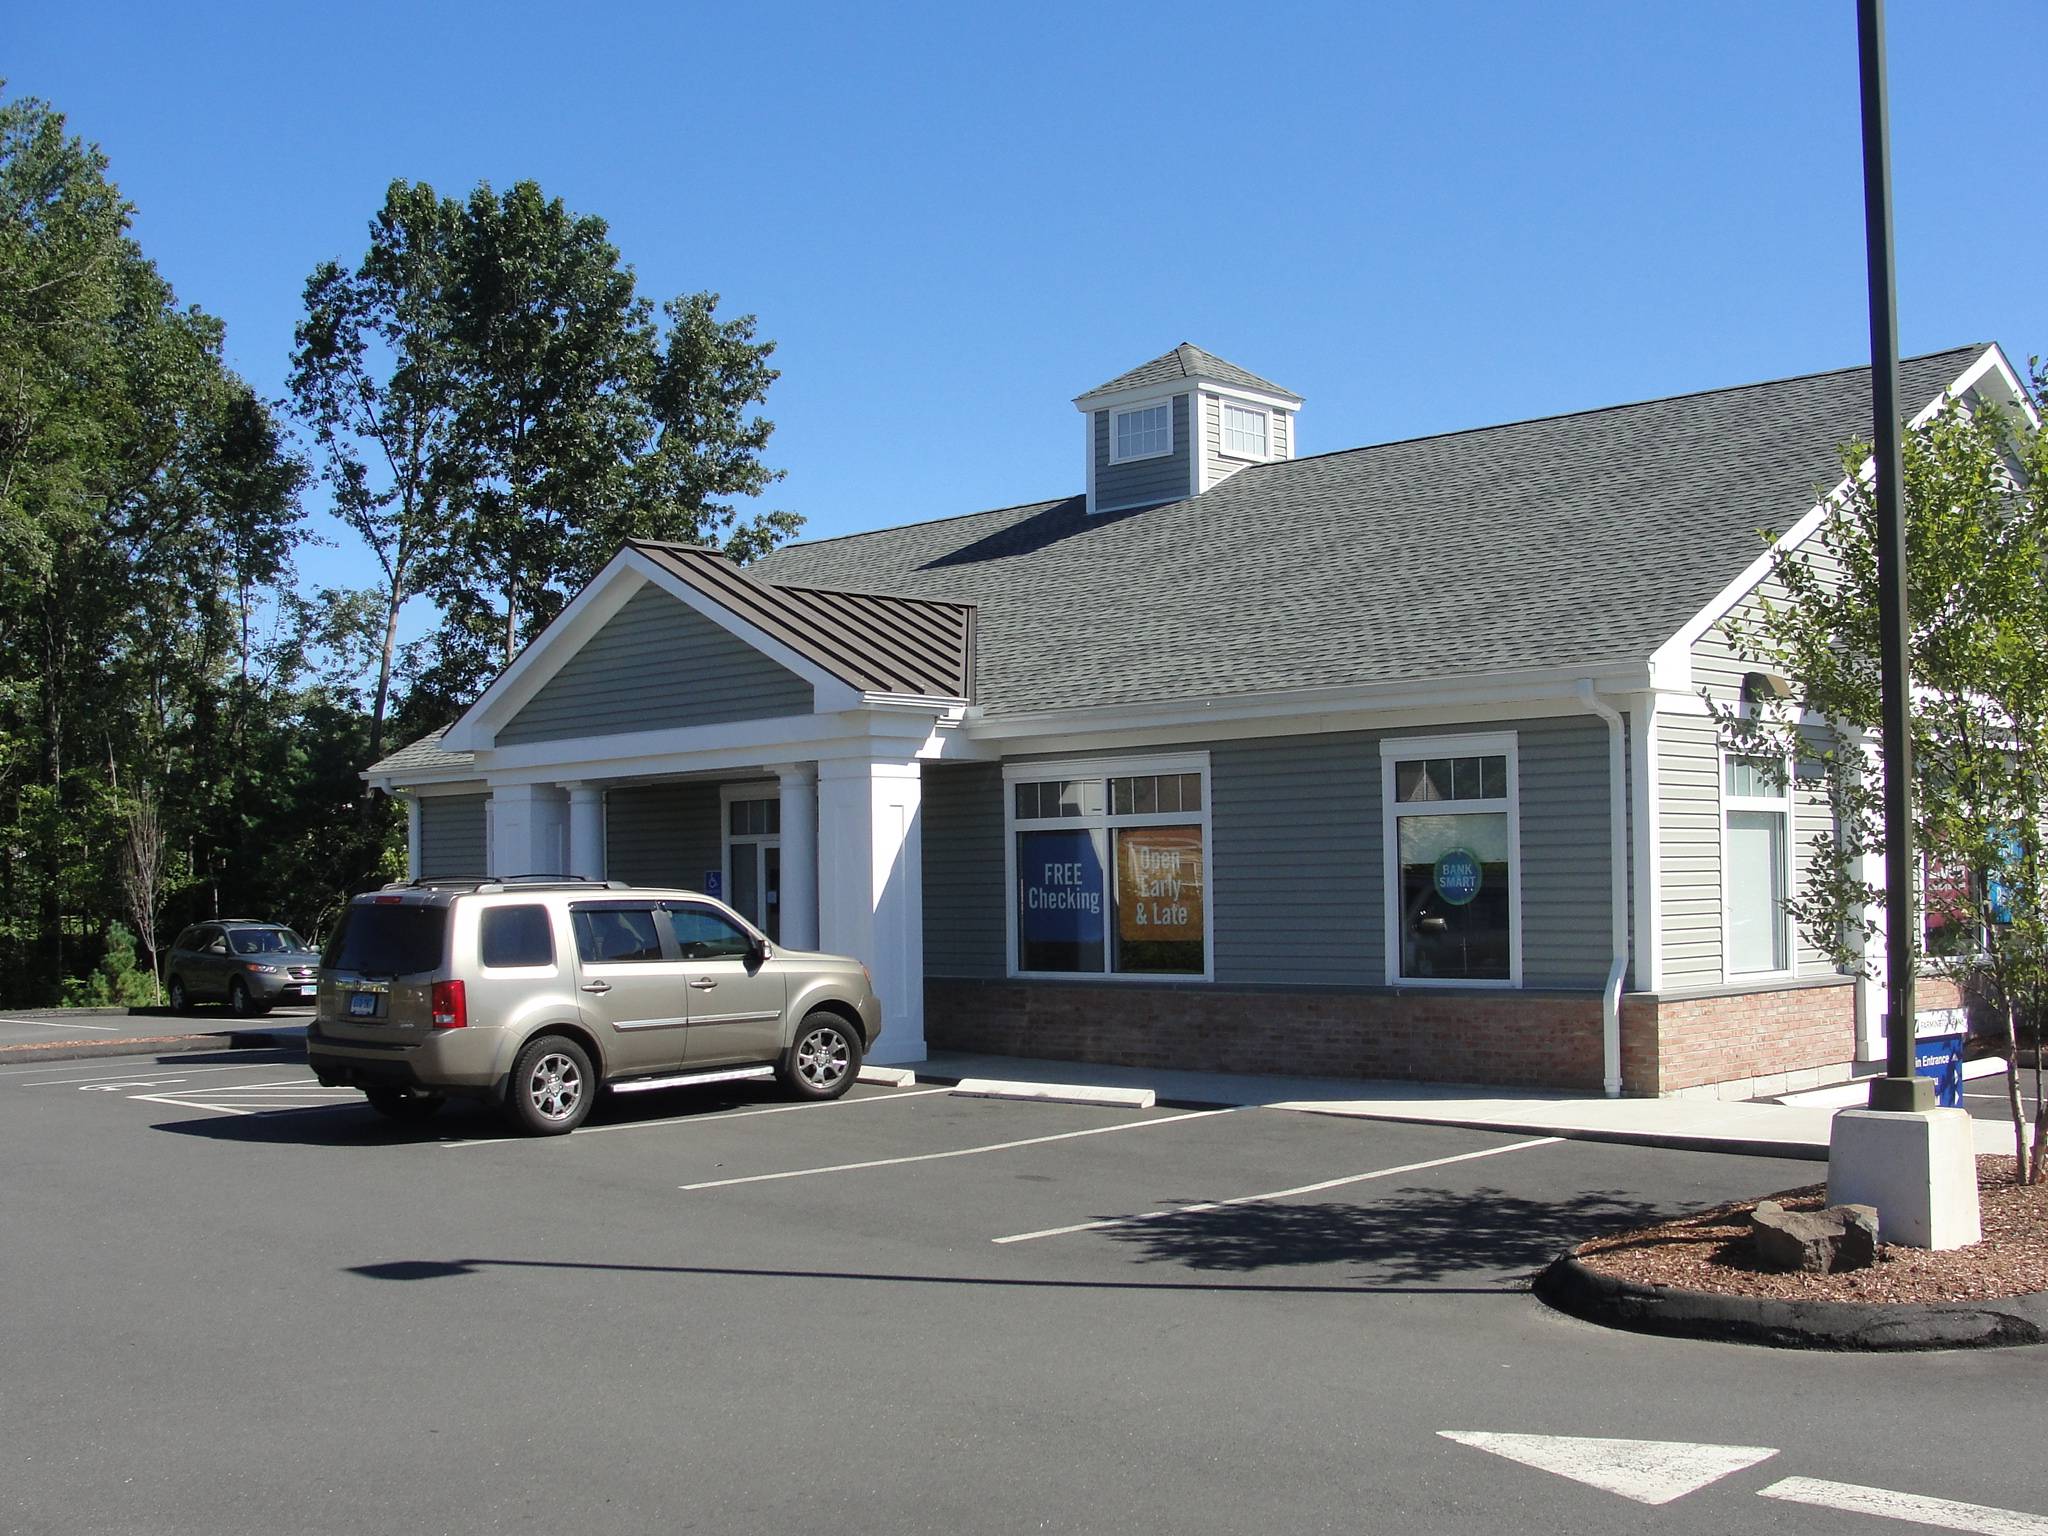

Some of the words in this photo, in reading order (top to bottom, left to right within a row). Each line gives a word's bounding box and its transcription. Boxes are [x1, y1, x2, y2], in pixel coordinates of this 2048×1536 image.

[1141, 846, 1180, 873] Open
[1442, 863, 1473, 876] BANK
[1044, 863, 1083, 885] FREE
[1439, 875, 1477, 888] SMART
[1139, 874, 1181, 902] Early
[1028, 887, 1100, 914] Checking
[1136, 902, 1148, 925] &
[1153, 902, 1188, 925] Late
[1923, 1055, 1950, 1067] Entrance
